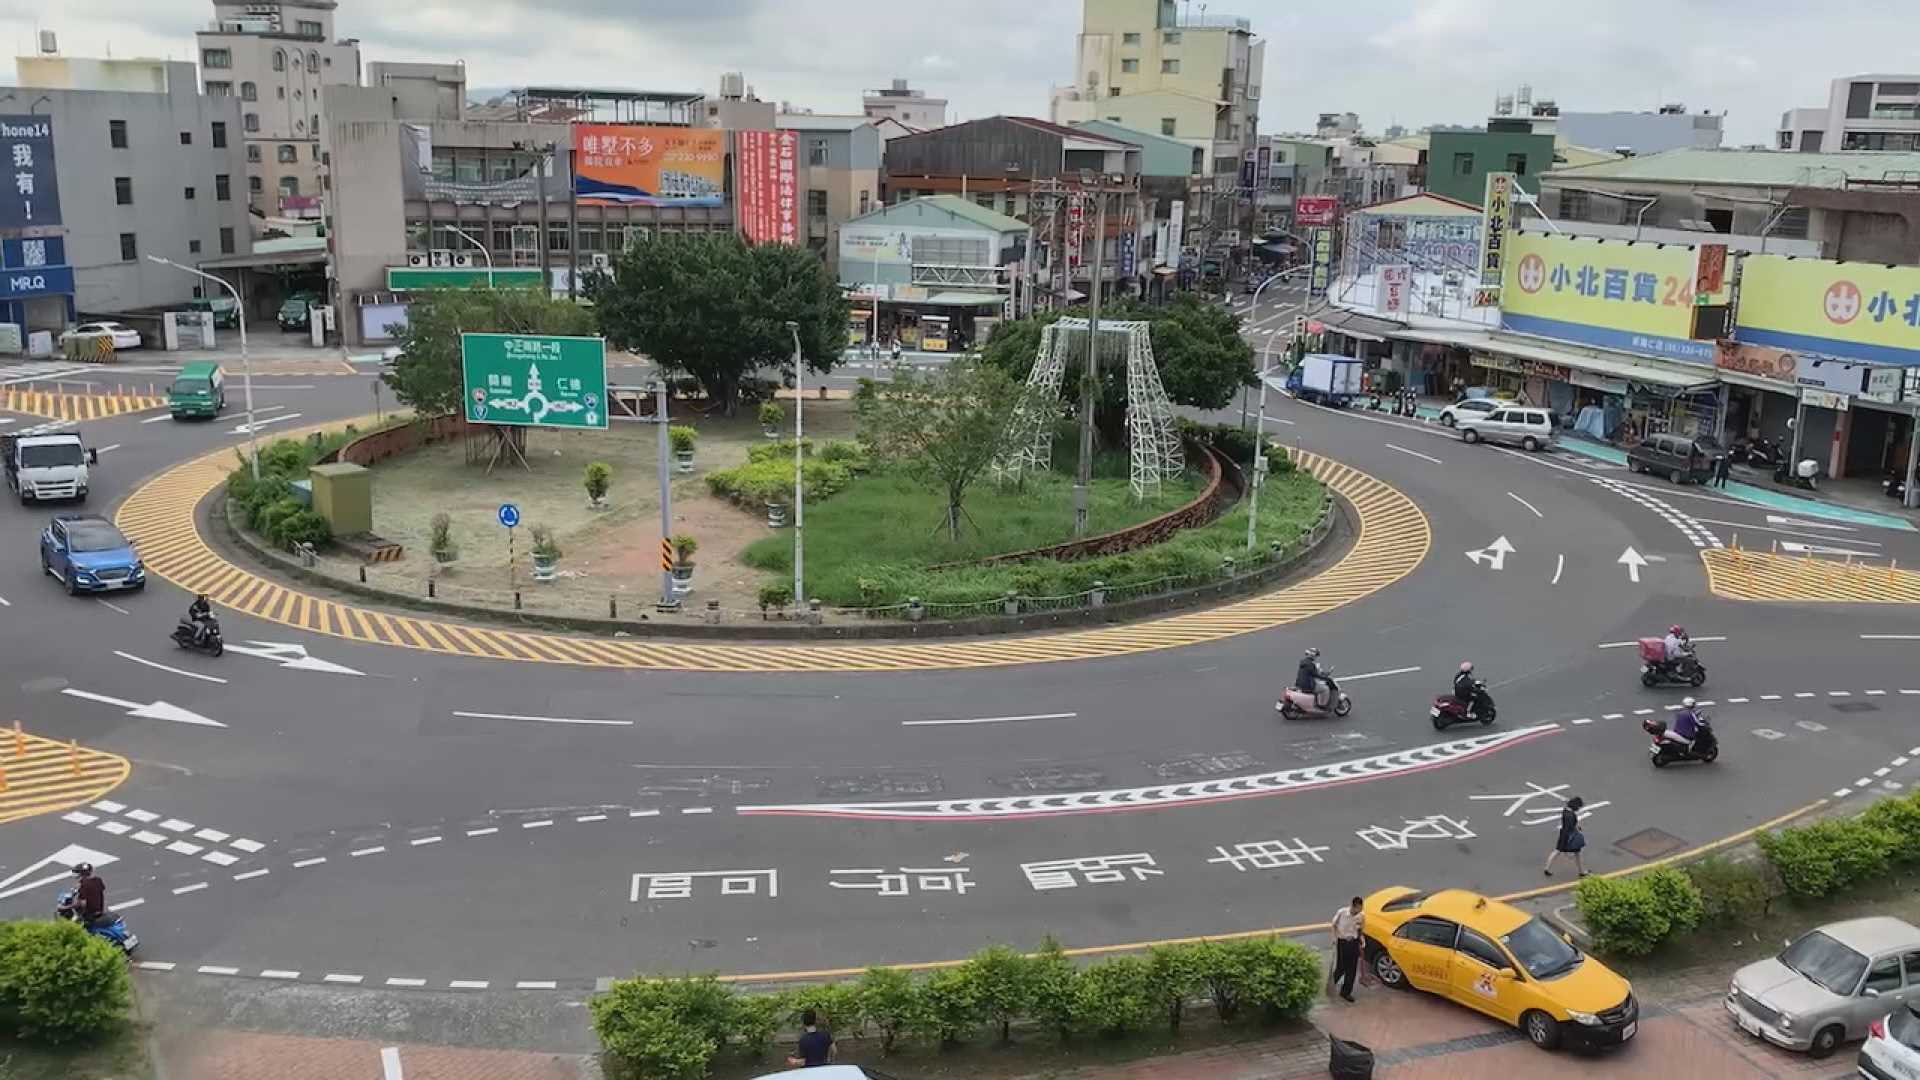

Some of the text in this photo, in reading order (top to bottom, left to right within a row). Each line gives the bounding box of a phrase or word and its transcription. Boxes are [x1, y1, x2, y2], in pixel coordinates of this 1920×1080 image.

[1487, 195, 1505, 269] 小北百貨
[1550, 262, 1658, 304] 小北百貨
